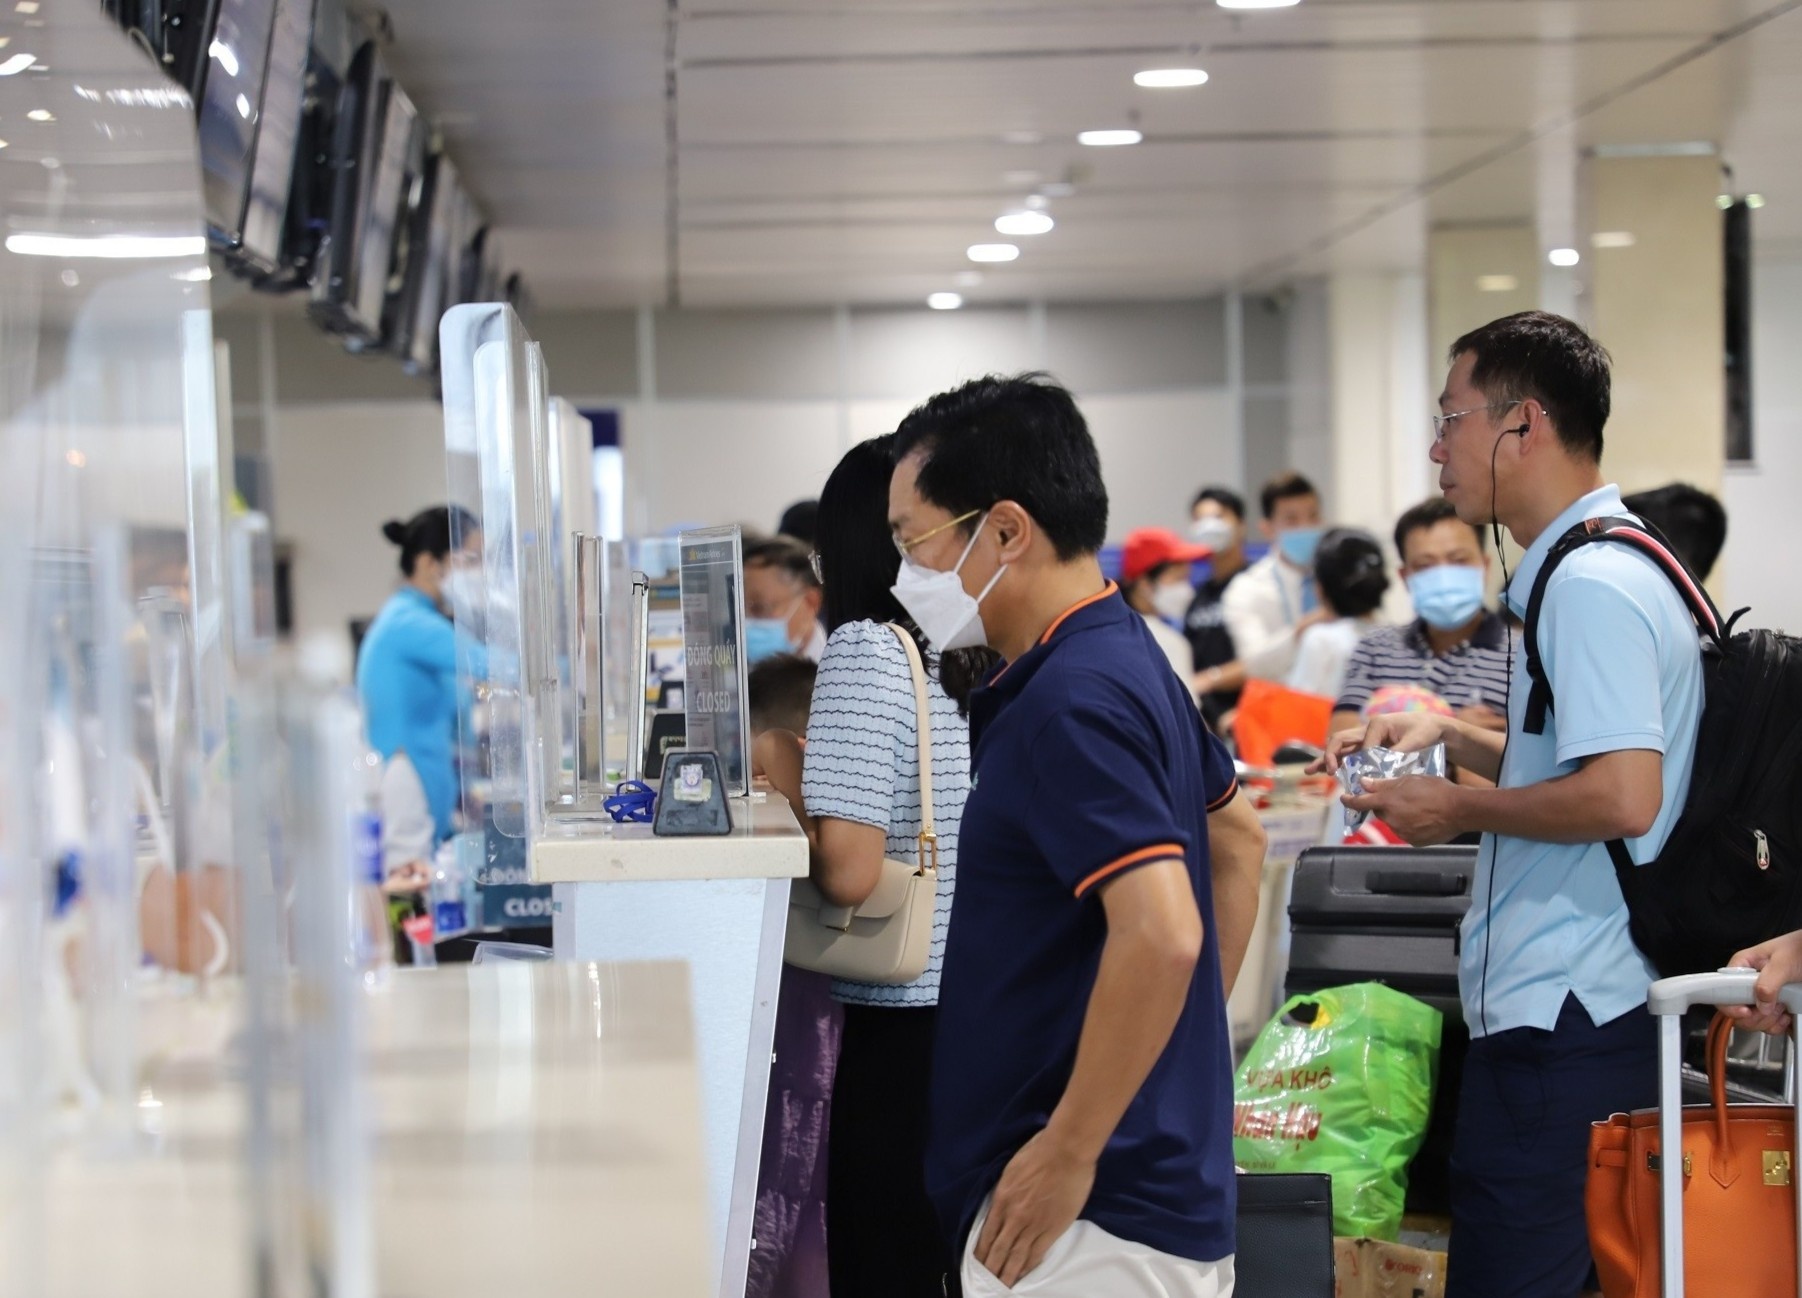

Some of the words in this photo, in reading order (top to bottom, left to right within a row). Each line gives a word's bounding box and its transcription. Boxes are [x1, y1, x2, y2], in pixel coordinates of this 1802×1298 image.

[696, 690, 731, 713] CLOSED
[504, 897, 553, 917] CLOS
[1290, 1066, 1332, 1090] KHÔ
